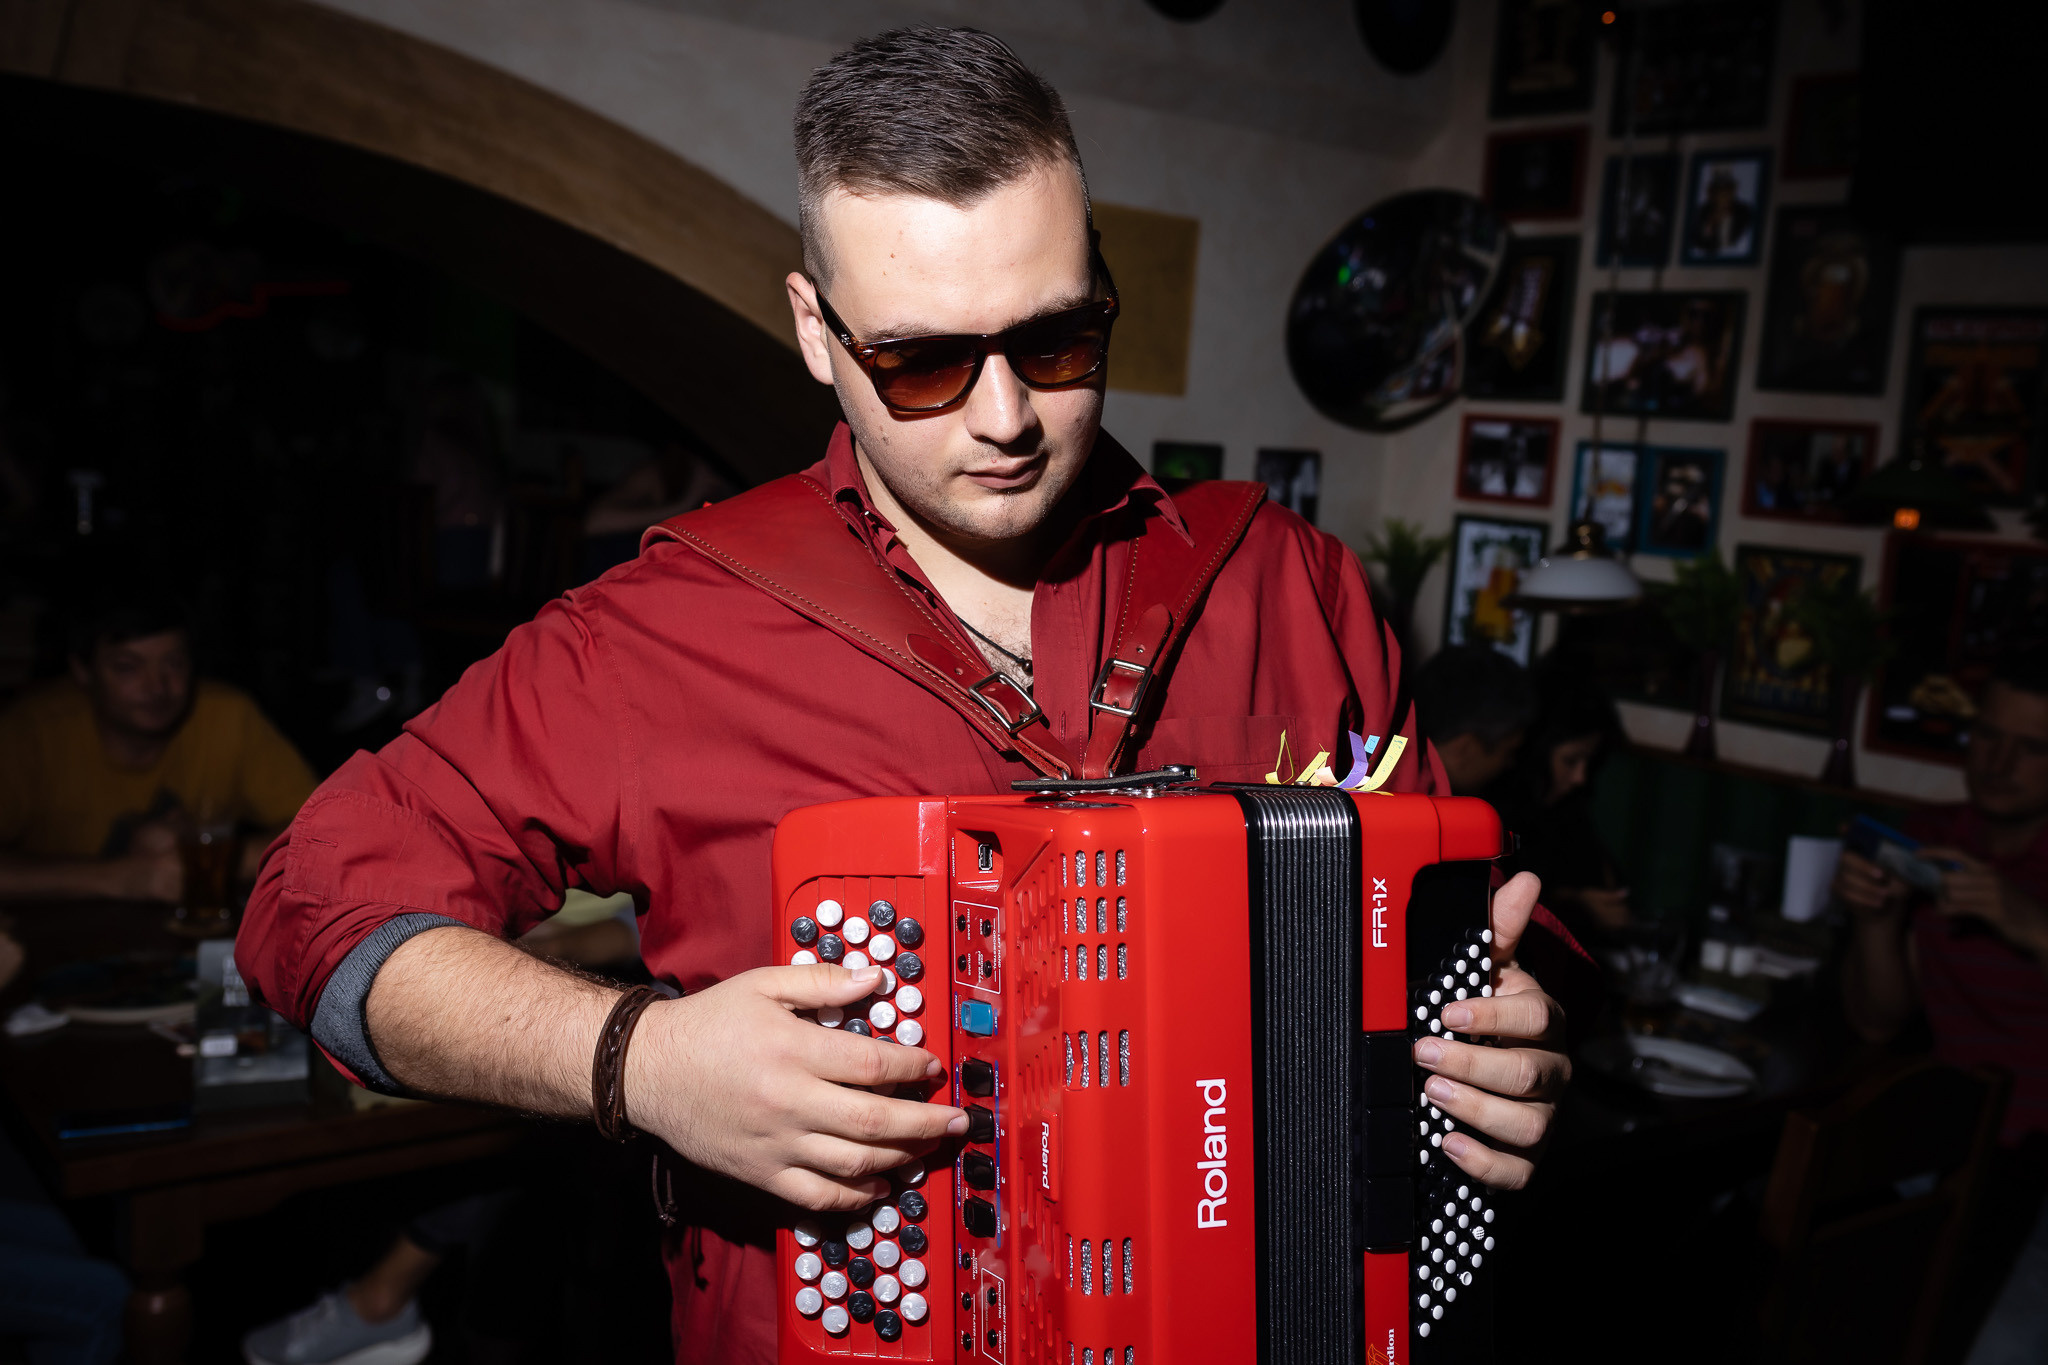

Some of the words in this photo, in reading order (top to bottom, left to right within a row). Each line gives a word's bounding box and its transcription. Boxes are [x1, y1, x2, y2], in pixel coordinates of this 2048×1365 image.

[1000, 1128, 1005, 1137] 2
[1041, 1121, 1050, 1189] Roland
[1196, 1078, 1228, 1229] Roland
[1001, 1176, 1006, 1184] 3
[1001, 1223, 1007, 1232] 4
